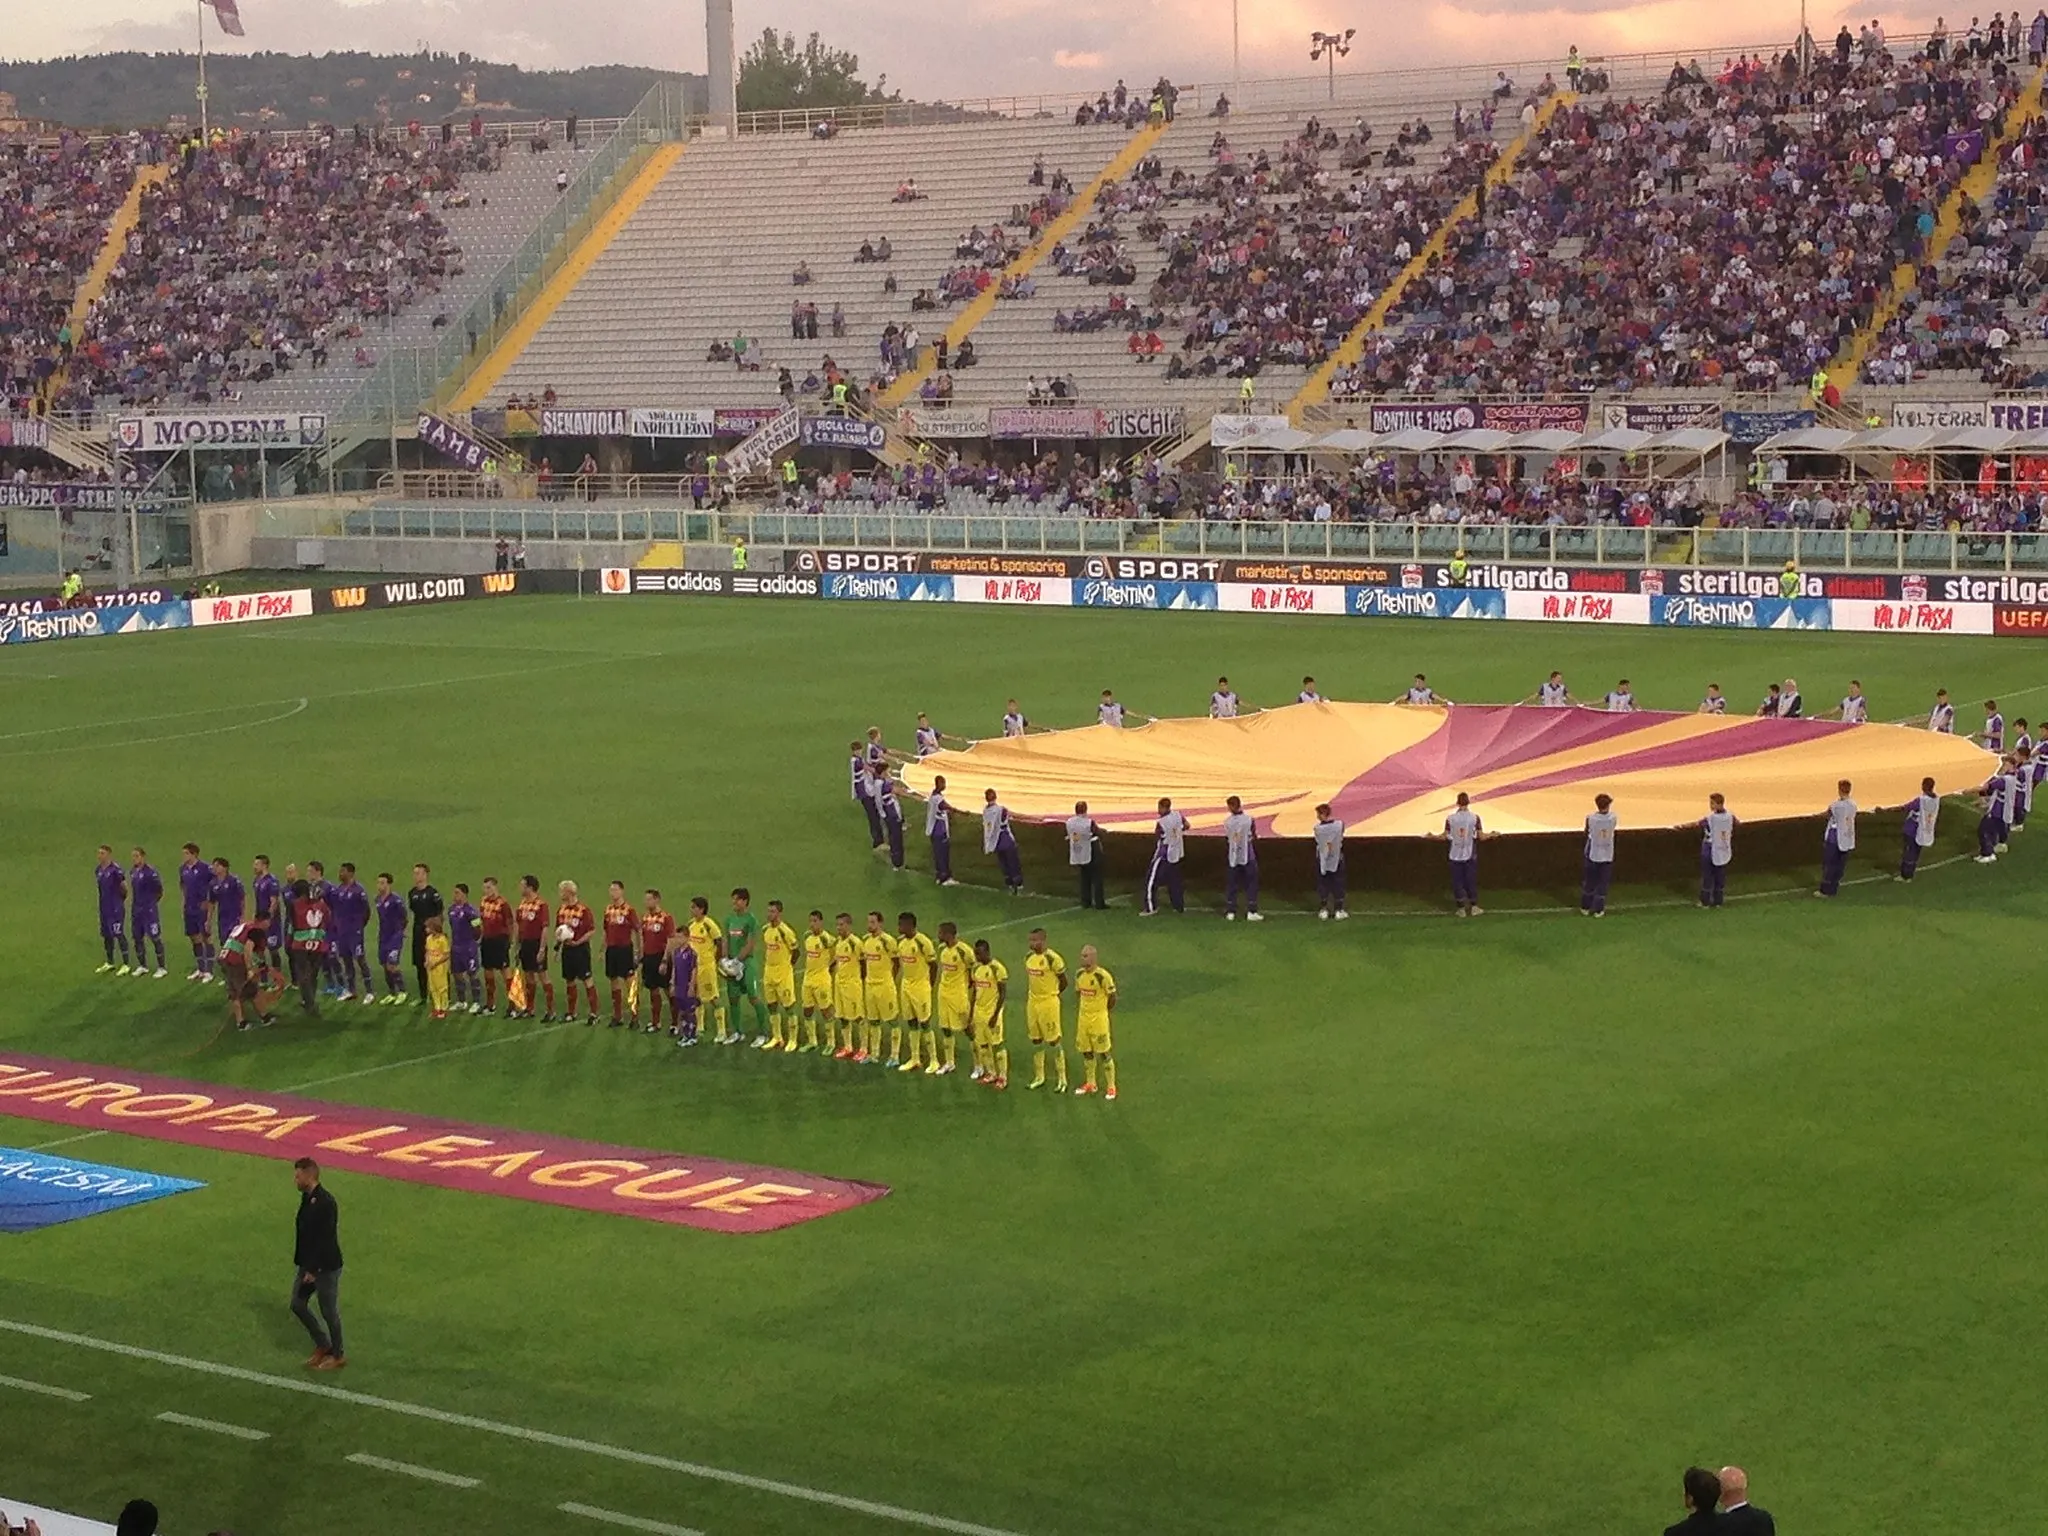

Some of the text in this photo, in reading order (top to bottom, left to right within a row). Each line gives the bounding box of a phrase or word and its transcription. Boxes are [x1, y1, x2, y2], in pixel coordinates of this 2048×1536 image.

[1373, 410, 1452, 432] MONTALE 1965
[1484, 406, 1581, 419] BOLZANO
[154, 418, 292, 445] MODENA
[827, 554, 916, 572] SPORT
[1119, 560, 1219, 580] SPORT
[385, 577, 465, 603] wu.com
[667, 572, 722, 592] adidas
[760, 574, 817, 595] adidas
[849, 576, 898, 598] TRENTINO
[1102, 582, 1156, 605] TRENTINO
[213, 594, 293, 622] VAL DI FASSA
[1375, 589, 1436, 614] TRENTINO
[1688, 599, 1753, 624] TRENTINO
[17, 611, 97, 638] TRENTINO
[1874, 603, 1953, 630] VAL DI FASSA
[0, 1064, 814, 1214] UROPA LEAGUE
[0, 1156, 153, 1196] ACISM
